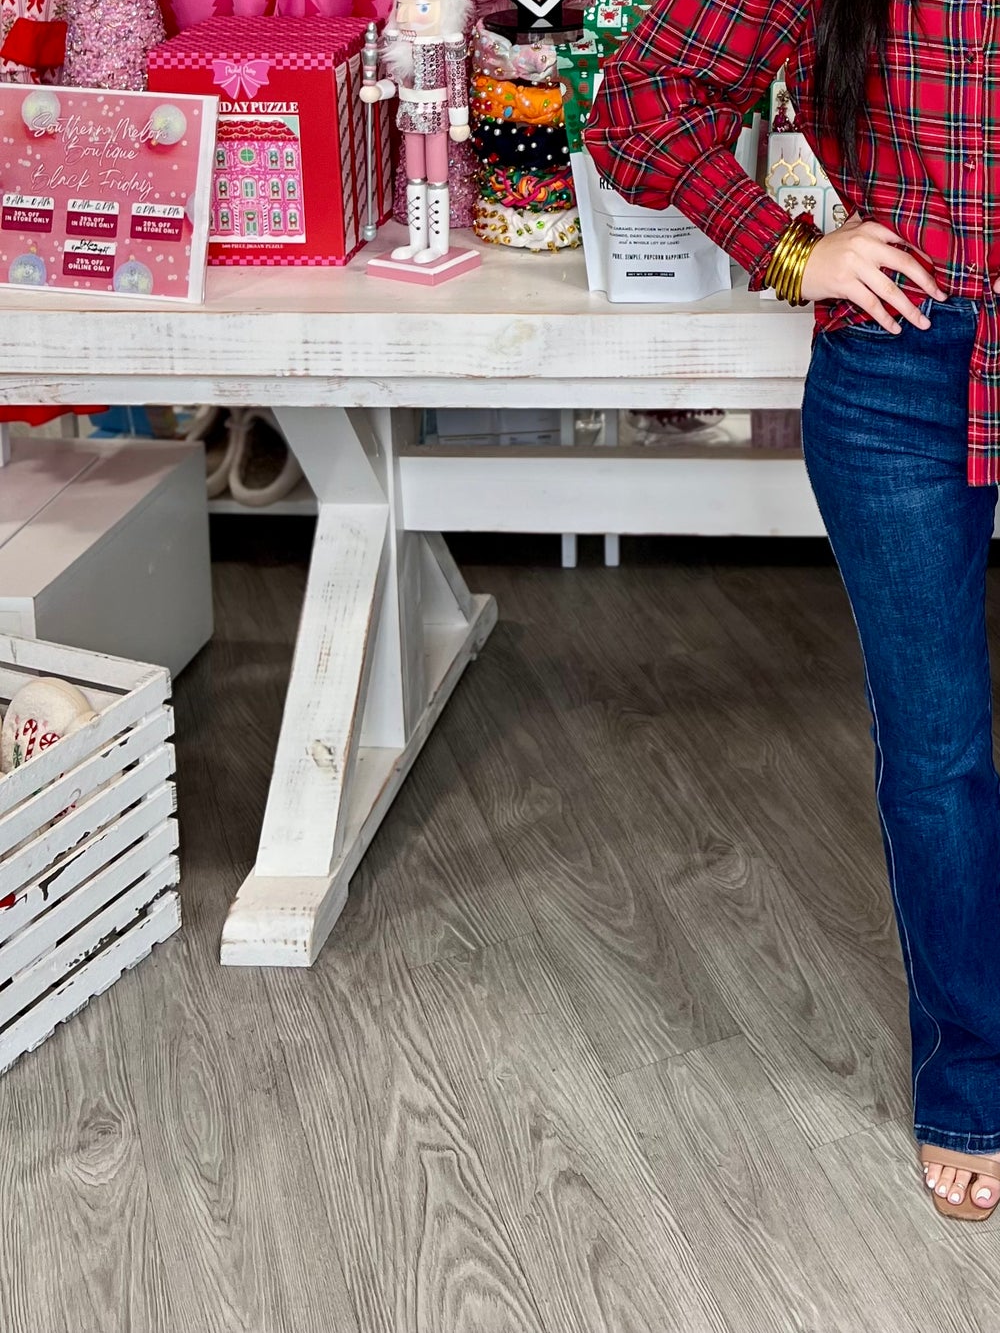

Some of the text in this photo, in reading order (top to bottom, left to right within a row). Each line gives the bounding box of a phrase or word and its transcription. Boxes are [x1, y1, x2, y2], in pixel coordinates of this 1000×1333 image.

[250, 101, 299, 113] PUZZLE
[33, 113, 167, 143] Southern Melon
[65, 136, 138, 166] Boutique
[32, 164, 154, 202] Black Friday
[68, 263, 111, 272] ONLINE ONLY
